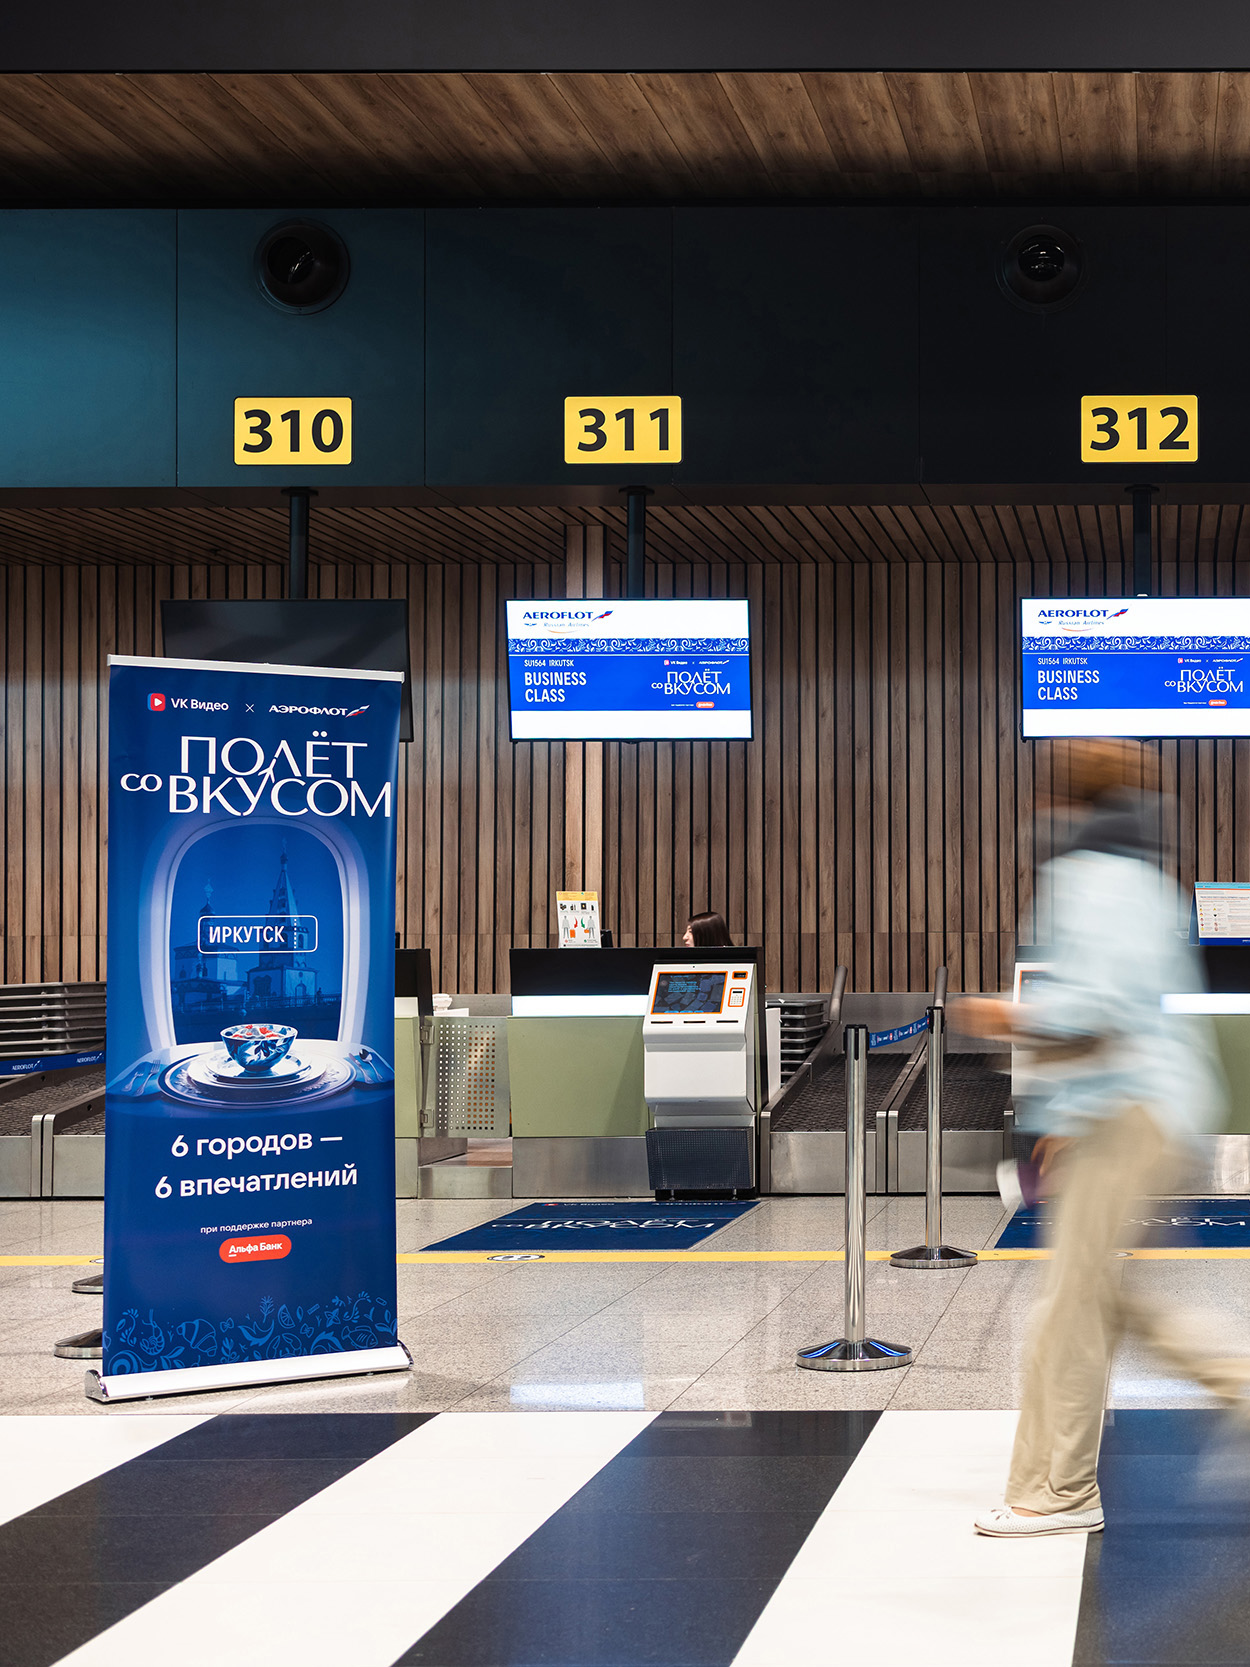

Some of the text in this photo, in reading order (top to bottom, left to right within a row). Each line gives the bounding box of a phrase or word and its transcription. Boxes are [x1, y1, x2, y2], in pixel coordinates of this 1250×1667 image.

[243, 409, 343, 453] 310
[578, 408, 668, 451] 311
[1090, 407, 1189, 450] 312
[523, 611, 593, 619] AEROFLOT
[524, 672, 587, 685] BUSINESS
[667, 669, 722, 683] ПОЛЁТ
[1038, 670, 1100, 683] BUSINESS
[1180, 667, 1235, 682] ПОЛЁТ
[664, 683, 730, 695] ВКУСОМ
[1038, 687, 1078, 700] CLASS
[1177, 680, 1243, 693] ВКУСОМ
[525, 689, 565, 702] CLASS
[171, 698, 188, 709] VK
[191, 699, 229, 711] Видео
[268, 705, 348, 716] АЭРОФЛОТ
[181, 731, 368, 778] ПОЛЁТ
[169, 774, 391, 817] ВКУСОМ
[209, 925, 285, 943] ИРКУТСК
[171, 1135, 189, 1157] 6
[197, 1132, 313, 1160] городов
[155, 1164, 358, 1199] 6 впечатлений
[220, 1222, 269, 1232] поддержке
[271, 1219, 313, 1228] партнера
[229, 1242, 283, 1256] Альфа Банк
